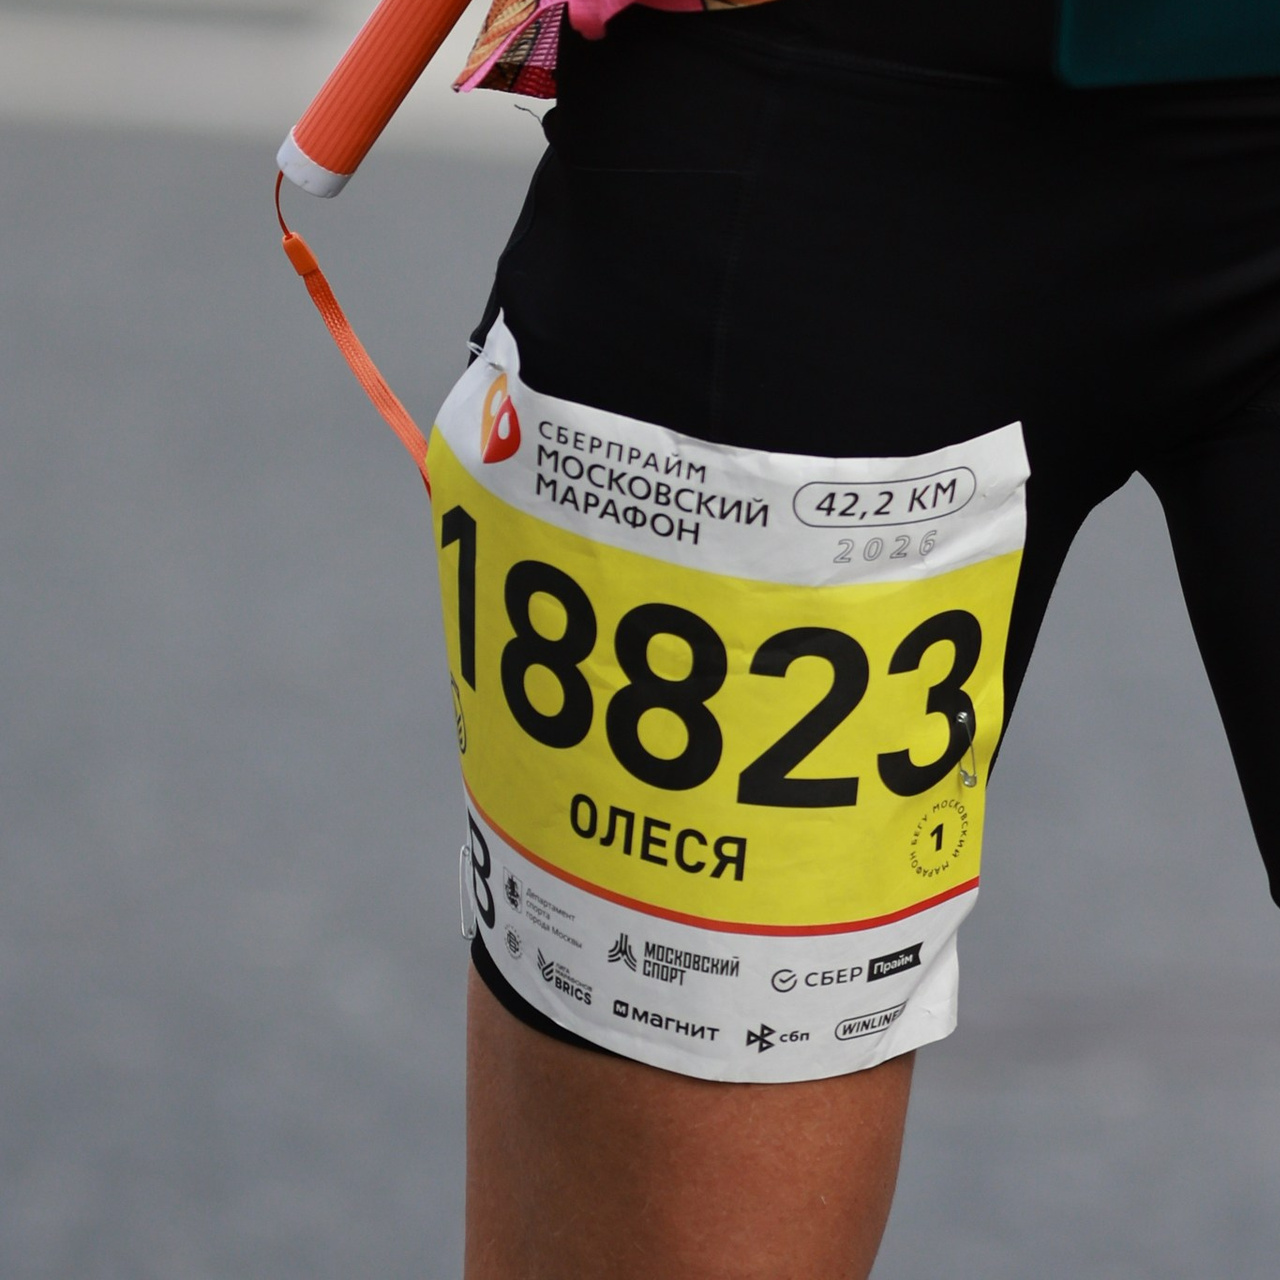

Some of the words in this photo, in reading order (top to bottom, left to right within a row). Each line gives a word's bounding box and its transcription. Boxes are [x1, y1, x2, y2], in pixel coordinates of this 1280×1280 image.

[538, 420, 707, 484] СБЕРПРАЙМ
[536, 444, 770, 528] МОСКОВСКИЙ
[815, 490, 894, 521] 42,2
[907, 478, 957, 513] КМ
[535, 472, 700, 546] МАРАФОН
[832, 529, 938, 564] 2026
[441, 505, 984, 808] 18823
[569, 792, 748, 882] ОЛЕСЯ
[930, 823, 944, 852] 1
[642, 959, 687, 986] СПОРТ
[643, 941, 740, 977] МОСКОВСКИЙ
[804, 966, 863, 987] СБЕР
[873, 953, 914, 975] Прайм
[555, 976, 593, 1006] BRICS
